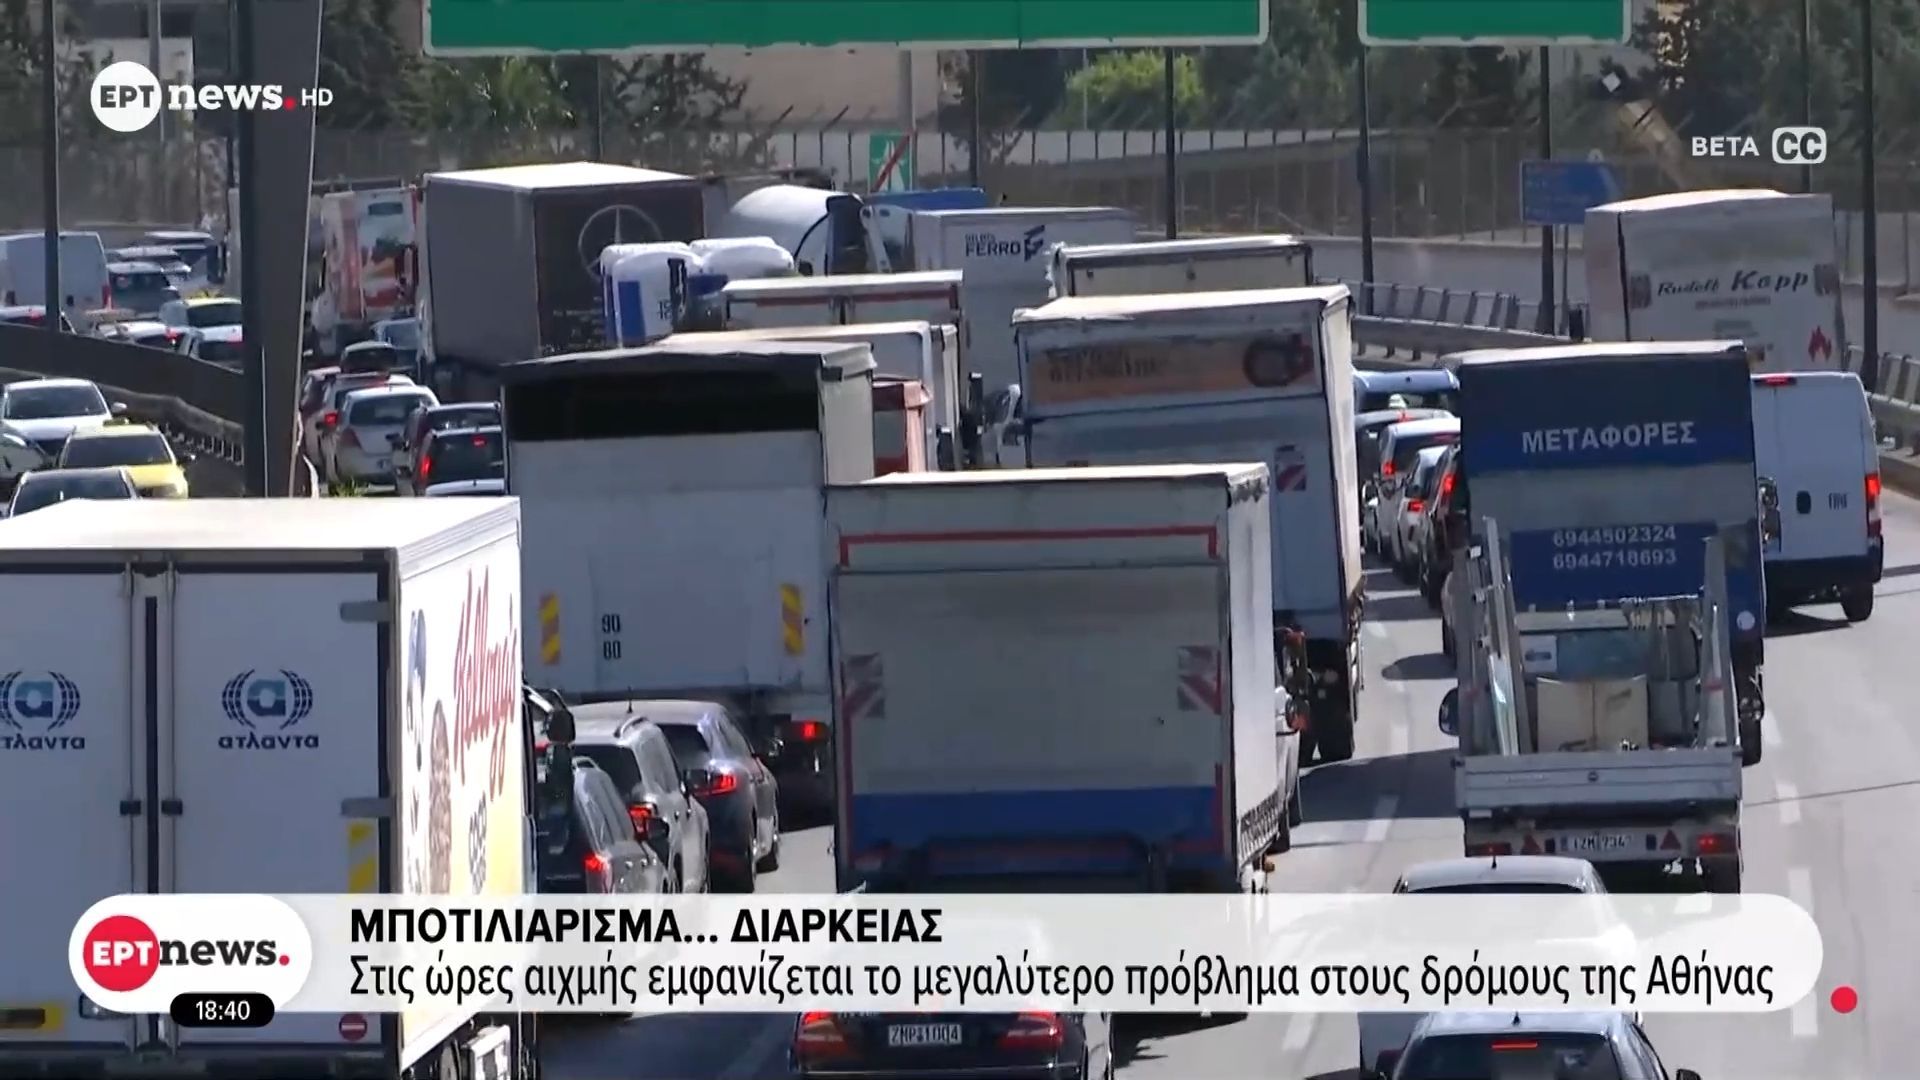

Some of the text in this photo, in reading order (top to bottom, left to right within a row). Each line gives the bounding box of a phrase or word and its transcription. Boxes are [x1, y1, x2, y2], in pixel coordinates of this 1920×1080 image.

[965, 240, 1021, 256] FERRO
[1521, 421, 1697, 453] ΜΕΤΑΦΟΡΕΣ
[601, 614, 621, 633] 90
[603, 641, 622, 660] 80
[453, 565, 518, 803] Kellogg's
[217, 731, 319, 750] ατλαντα
